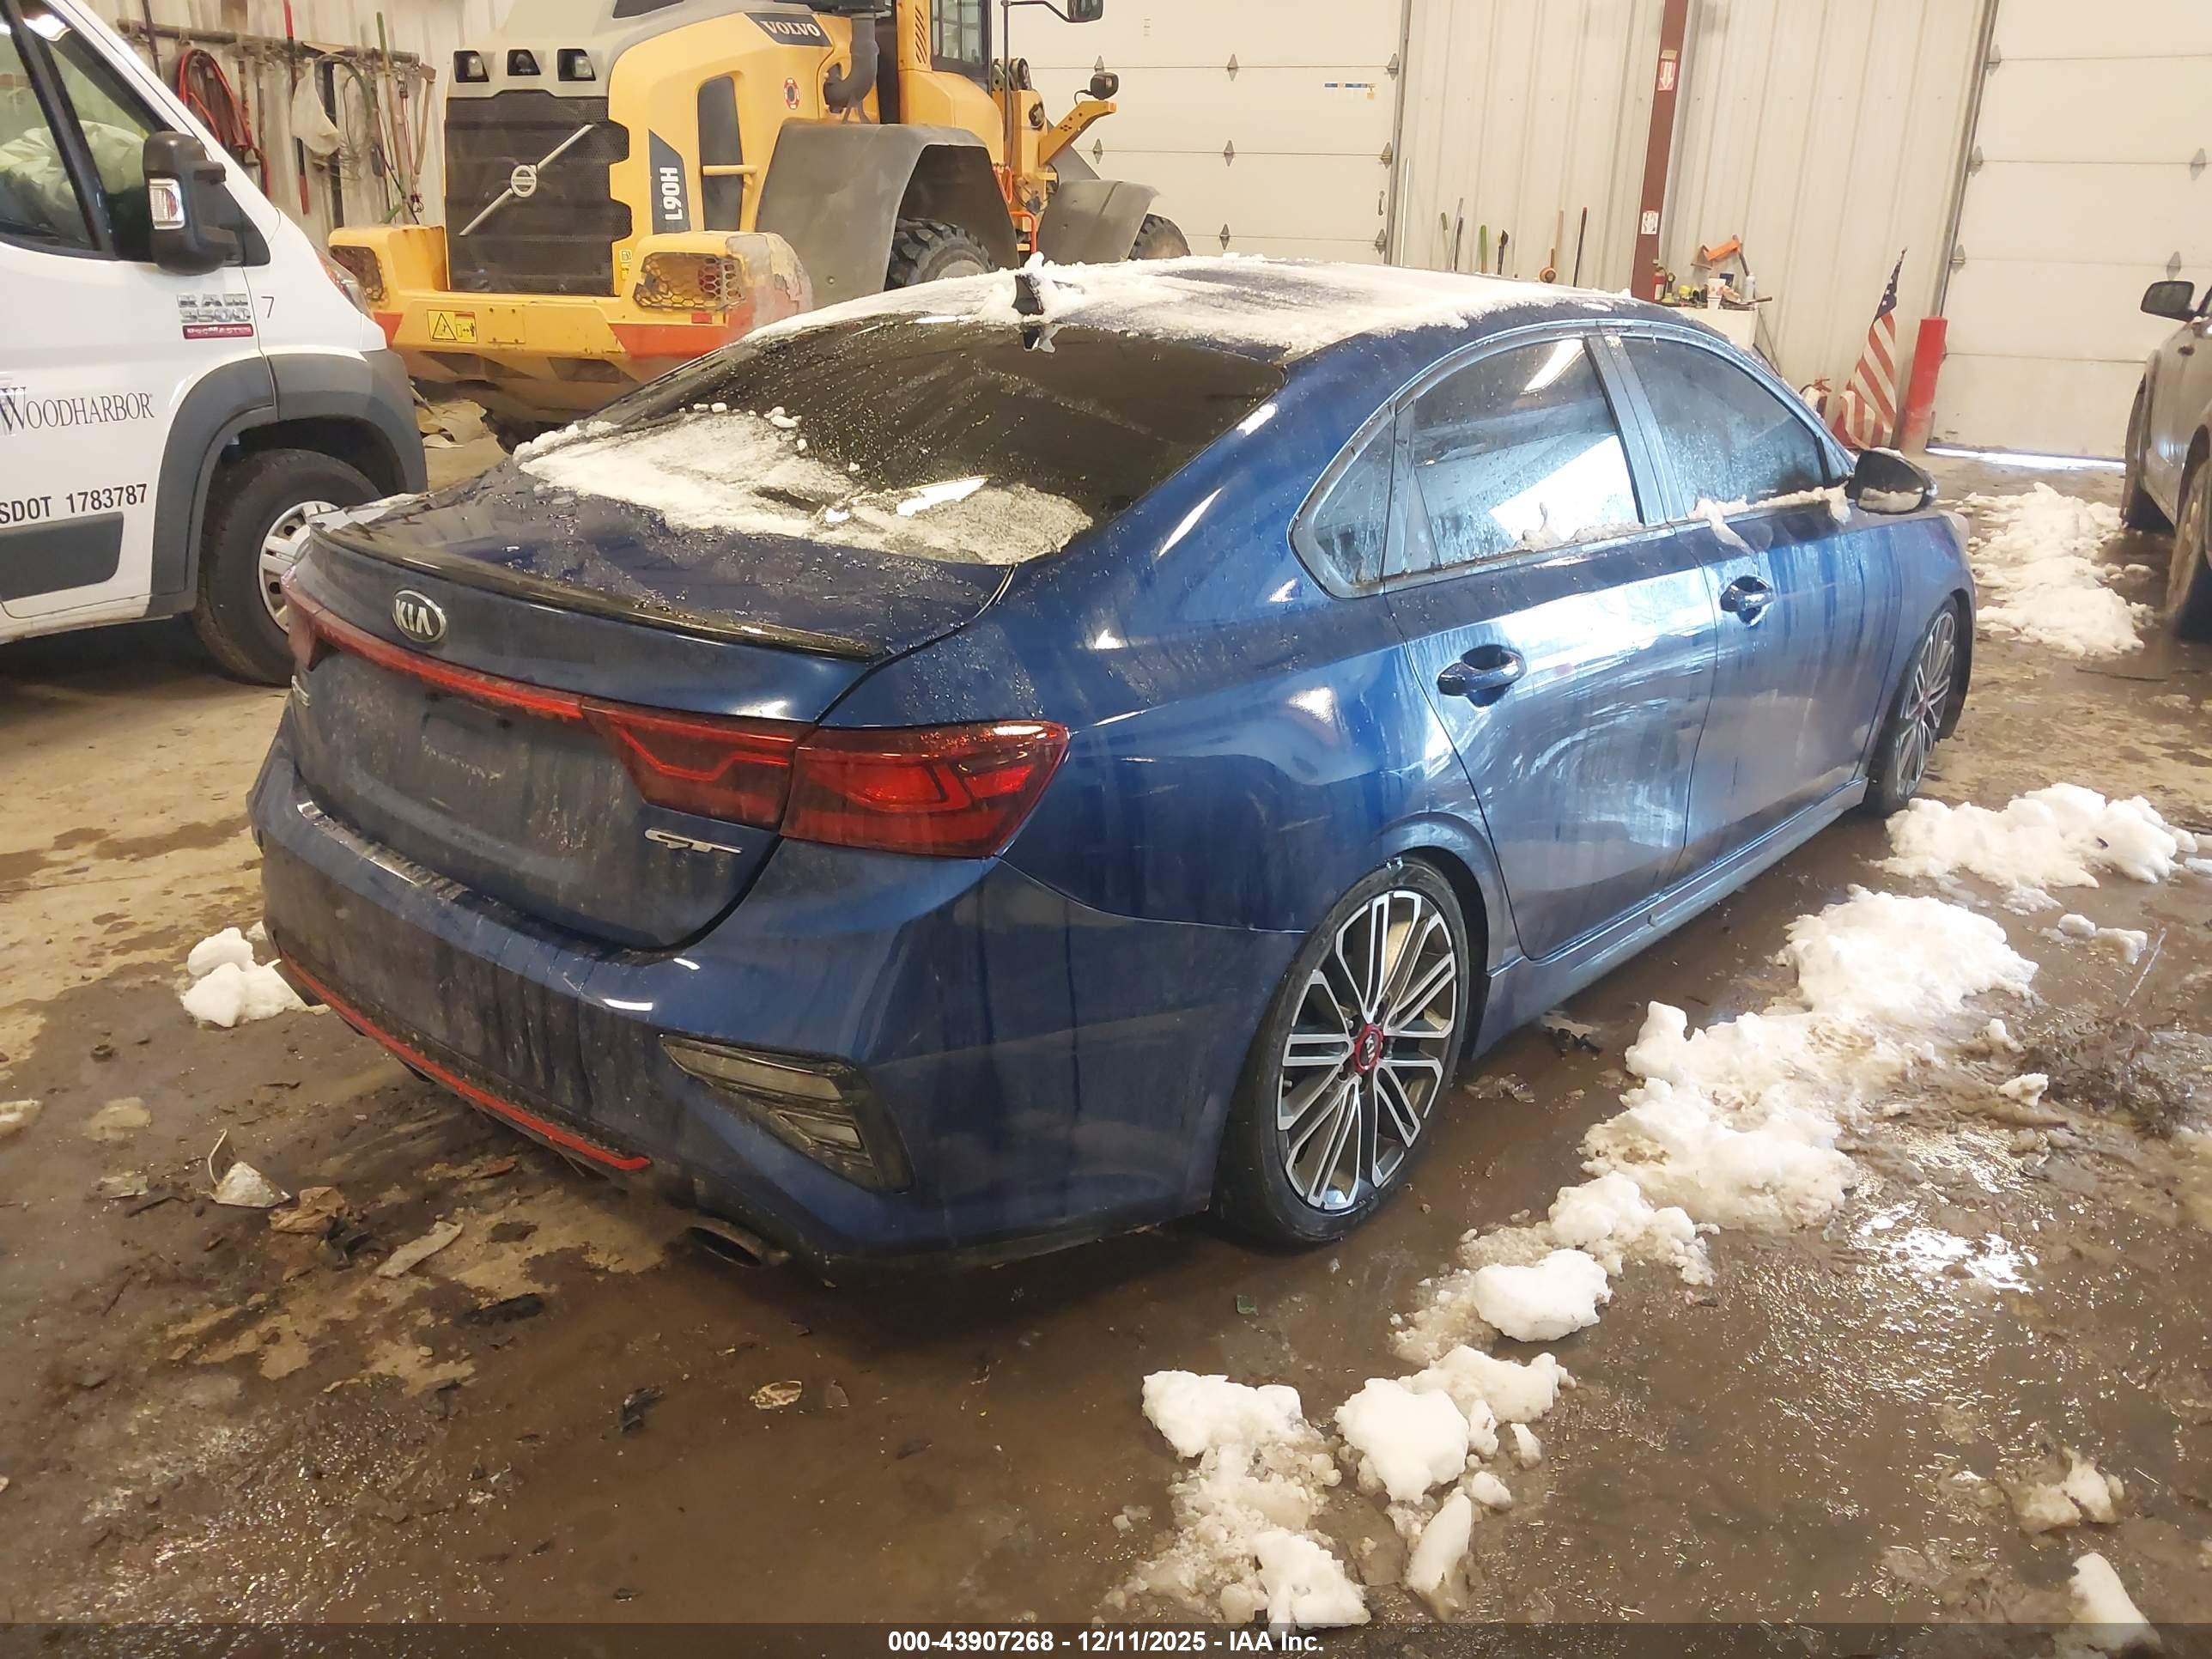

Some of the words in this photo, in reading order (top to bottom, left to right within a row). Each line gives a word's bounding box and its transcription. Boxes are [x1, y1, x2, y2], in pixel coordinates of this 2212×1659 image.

[759, 20, 821, 37] VOLVO
[659, 167, 684, 221] L90H
[260, 295, 275, 319] 7
[0, 386, 155, 432] WOODHARBOR
[65, 483, 148, 514] 1783787
[395, 599, 434, 636] KIA
